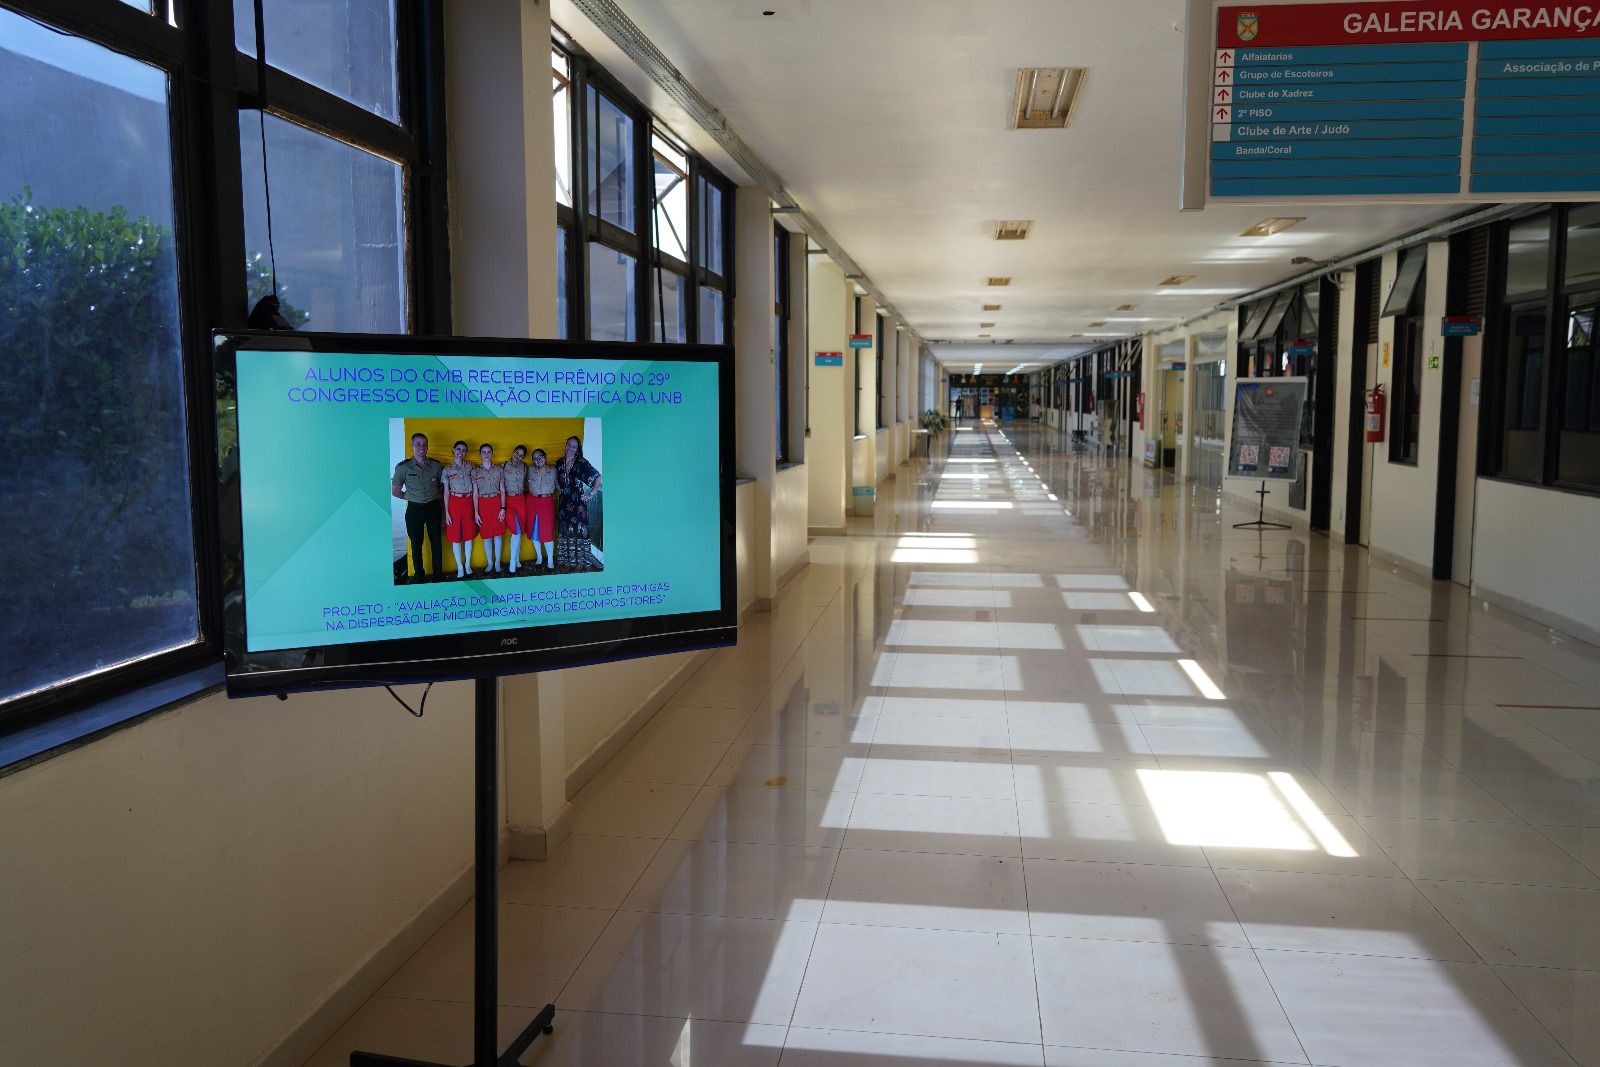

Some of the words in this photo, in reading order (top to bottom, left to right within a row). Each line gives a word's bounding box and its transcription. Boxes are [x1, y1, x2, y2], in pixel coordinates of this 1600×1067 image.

[1343, 10, 1463, 34] GALERIA
[1241, 53, 1293, 61] Alfaiatarias
[1503, 62, 1572, 73] Associação
[1575, 62, 1589, 70] de
[1240, 71, 1268, 80] Grupo
[1284, 70, 1333, 78] Escoteiros
[1282, 90, 1313, 98] Xadrez
[1238, 127, 1269, 135] Clube
[1273, 126, 1286, 135] de
[1289, 126, 1312, 134] Arte
[1314, 125, 1319, 134] /
[1322, 125, 1349, 134] Judô
[1236, 146, 1291, 154] Banda/Coral
[305, 367, 385, 382] ALUNOS
[390, 369, 417, 382] DO
[423, 369, 463, 383] CMB
[468, 369, 549, 384] RECEBEM
[555, 369, 616, 385] PRÊMIO
[621, 372, 644, 385] NO
[288, 387, 410, 402] CONGRESSO
[416, 388, 440, 403] DE
[446, 387, 531, 406] INICIAÇÃO
[535, 387, 622, 403] CIENTÍFICA
[626, 390, 647, 403] DA
[650, 391, 682, 404] UNB
[323, 603, 383, 617] PROJETO
[471, 595, 488, 606] DO
[491, 593, 527, 604] PAPEL
[530, 588, 596, 601] ECOLÓGICO
[598, 586, 613, 596] DE
[616, 582, 671, 594] FORMIGAS
[326, 620, 344, 631] NA
[348, 613, 420, 629] DISPERSÃO
[423, 612, 440, 622] DE
[444, 602, 560, 621] MICROORGANISMOS
